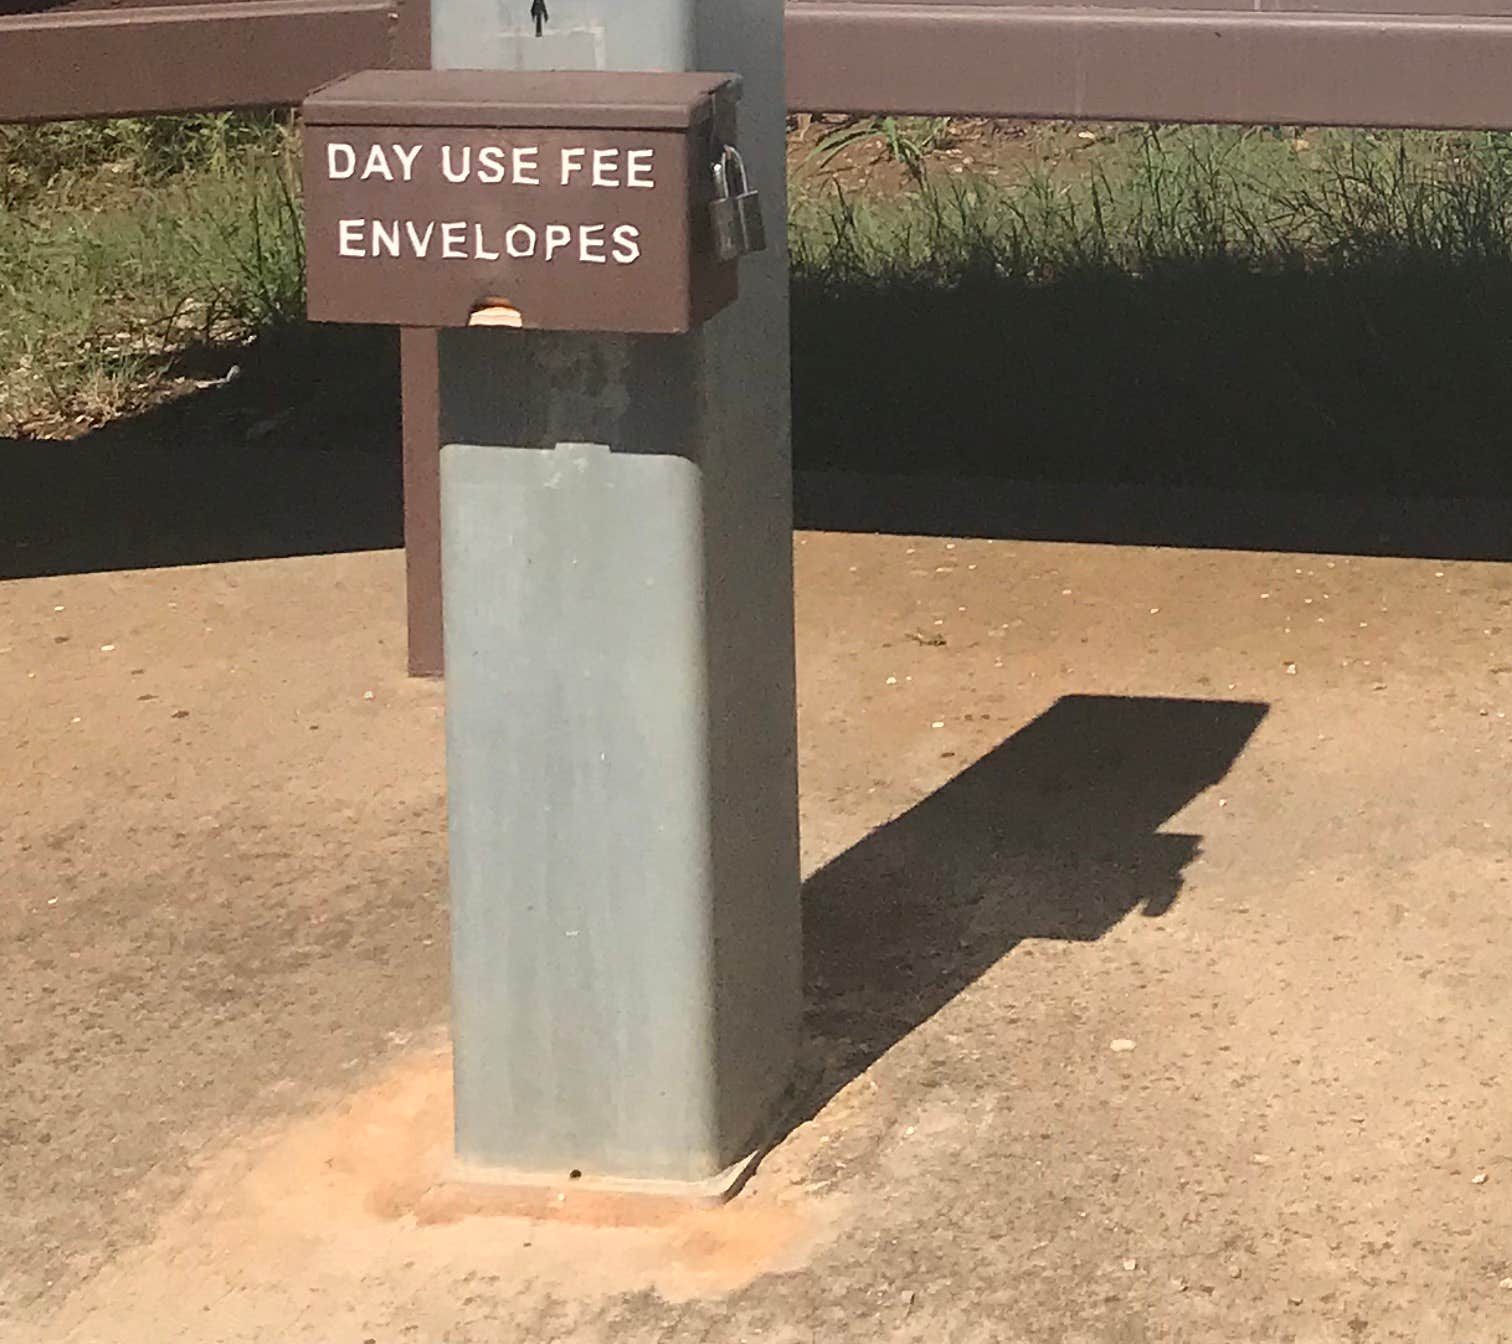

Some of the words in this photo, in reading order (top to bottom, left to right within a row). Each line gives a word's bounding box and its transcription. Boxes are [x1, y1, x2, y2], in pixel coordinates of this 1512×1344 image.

[327, 143, 423, 181] DAY
[441, 145, 540, 185] USE
[560, 147, 654, 188] FEE
[339, 218, 640, 263] ENVELOPES
